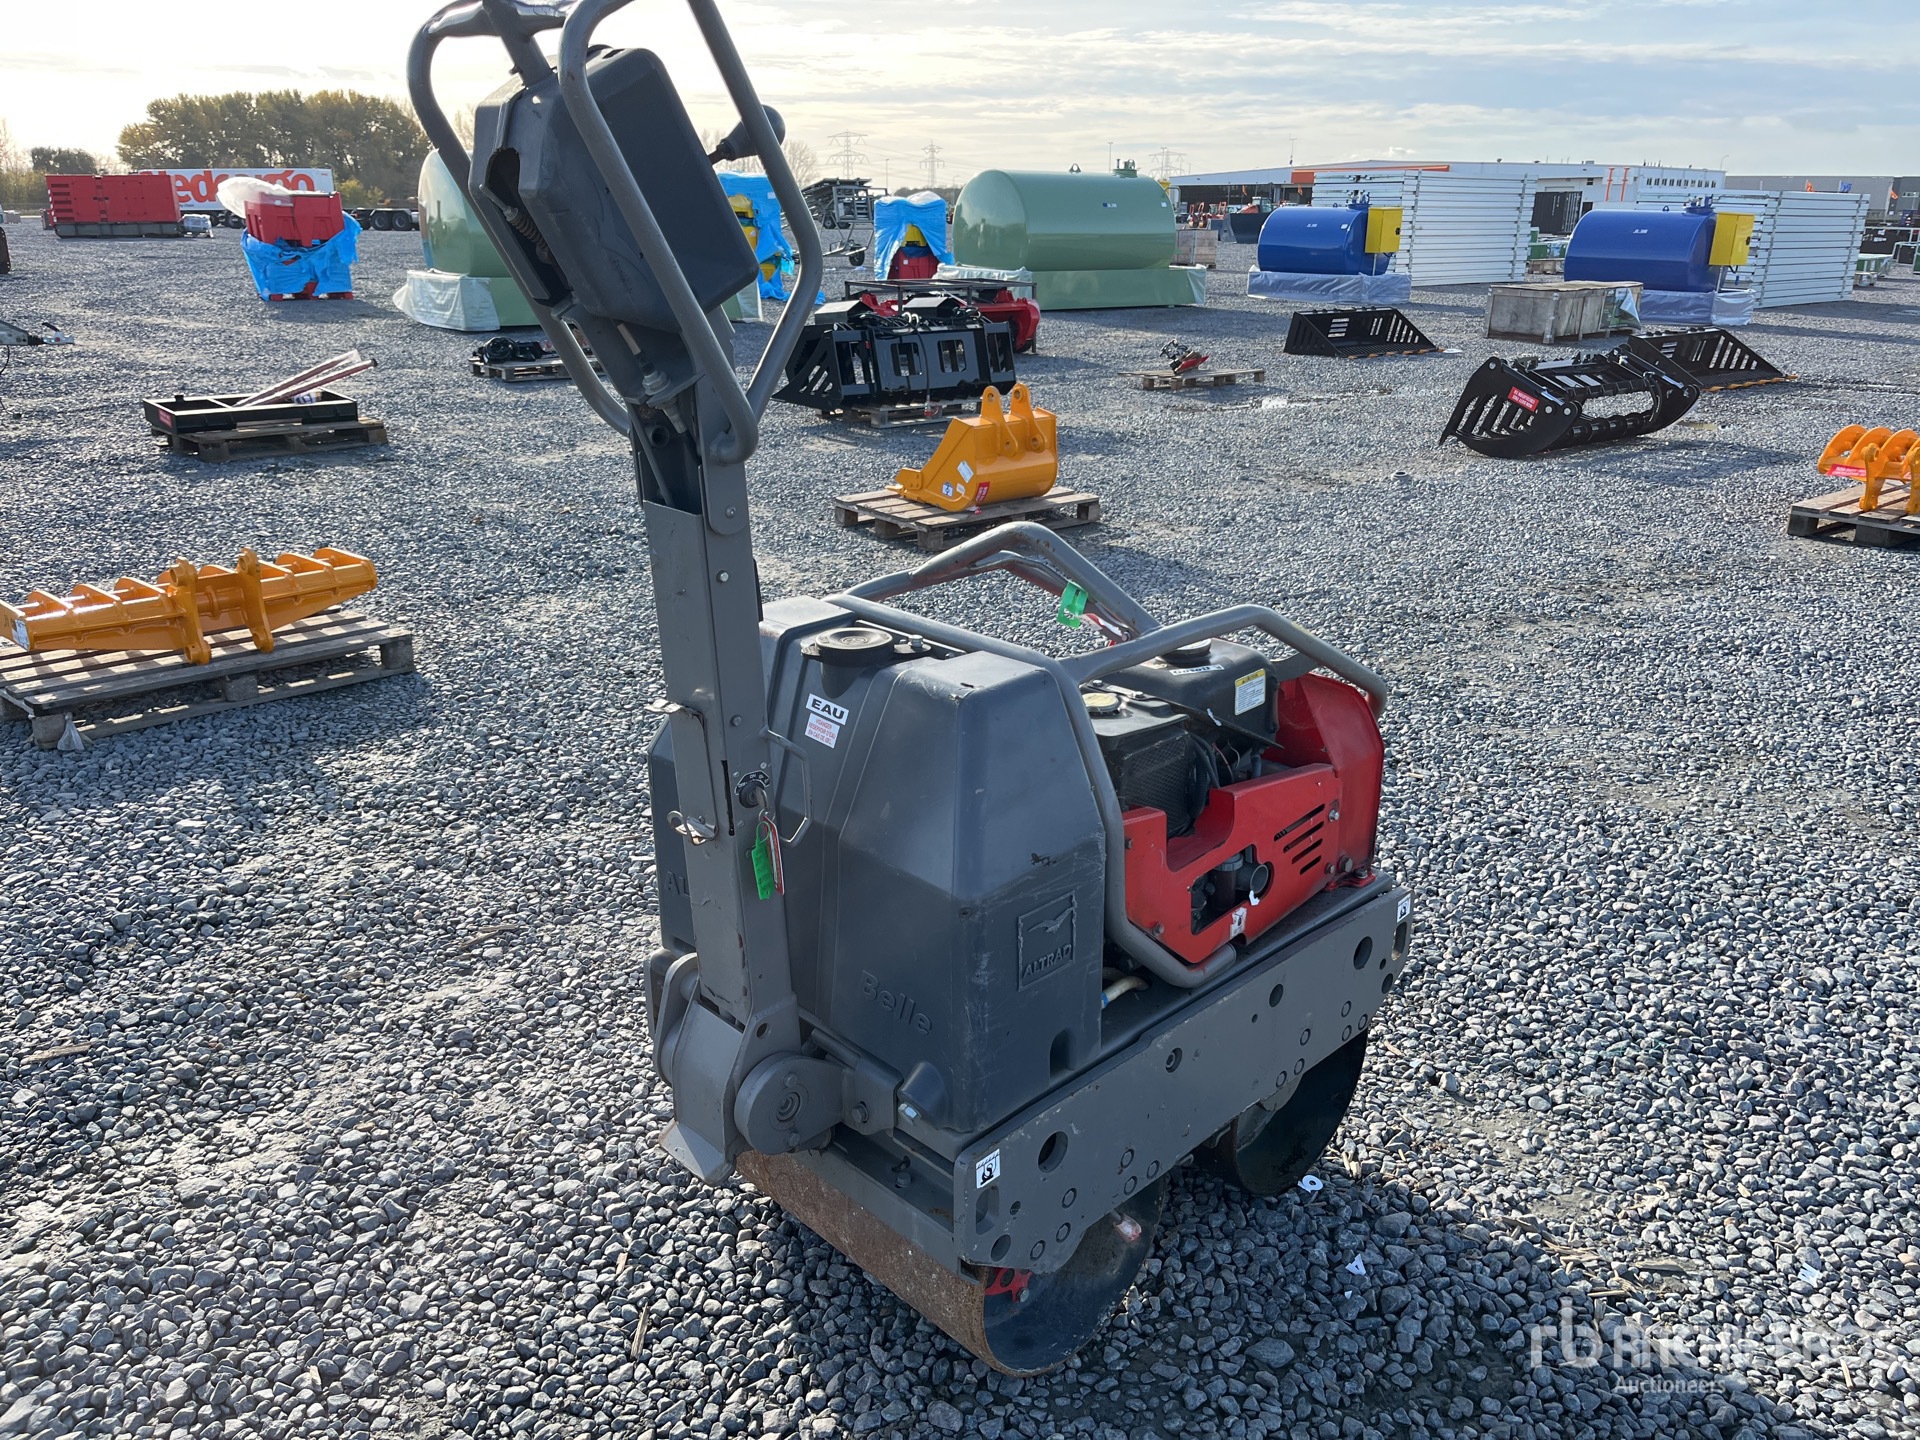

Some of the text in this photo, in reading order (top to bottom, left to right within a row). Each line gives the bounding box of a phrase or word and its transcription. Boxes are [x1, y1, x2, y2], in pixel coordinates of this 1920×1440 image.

[811, 698, 845, 720] EAU
[1021, 944, 1072, 979] ALTRAD
[860, 968, 933, 1036] Belle
